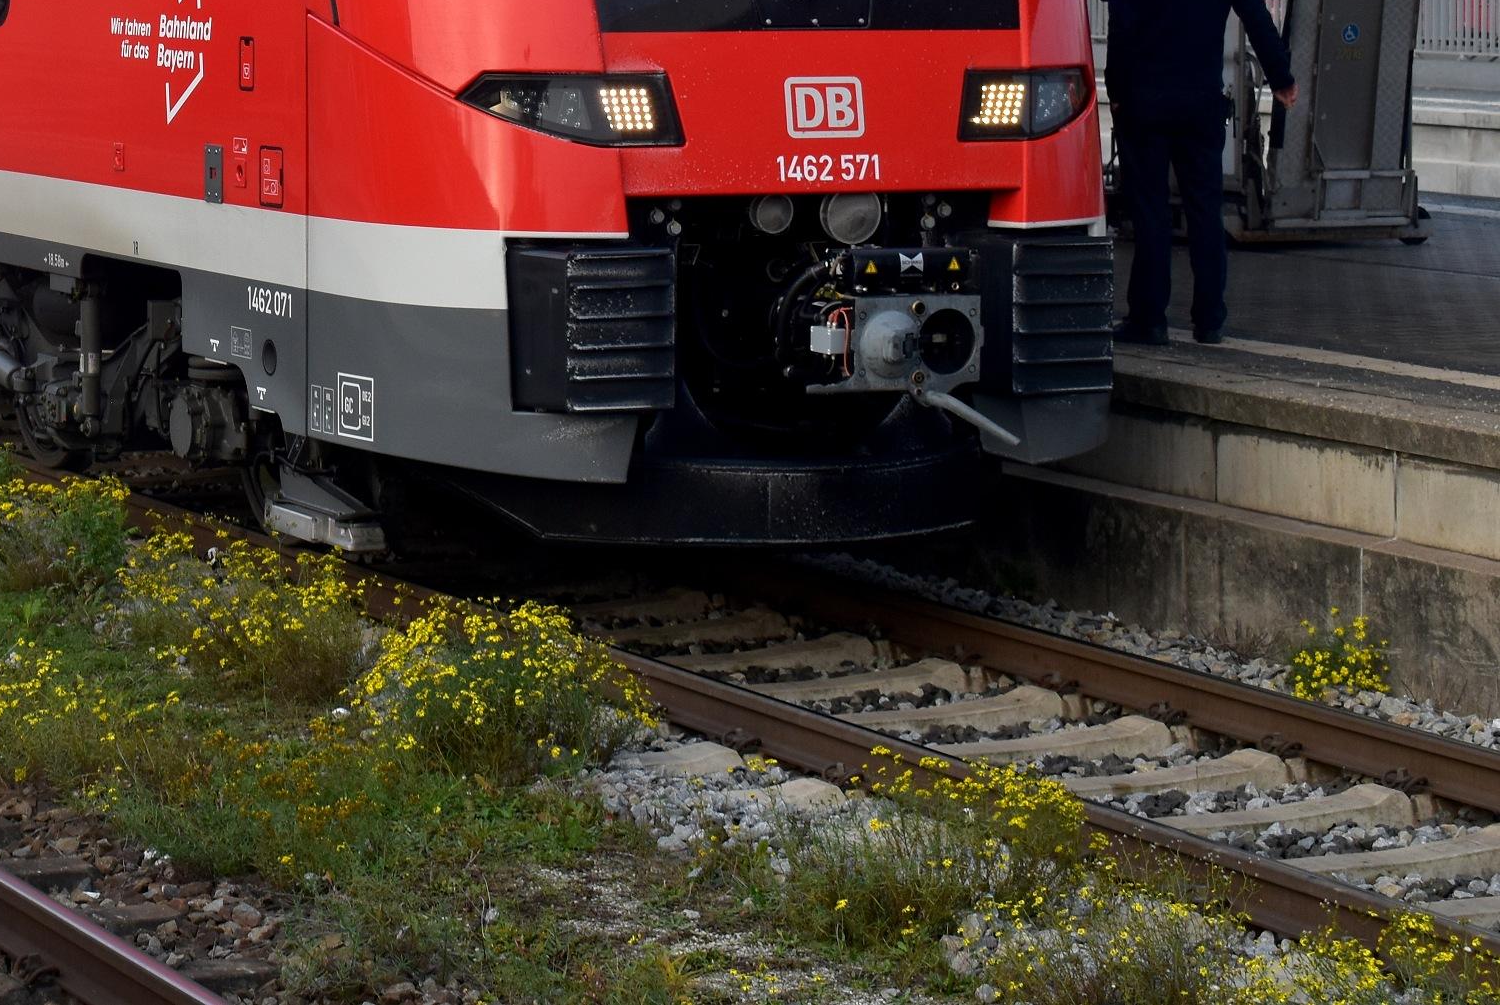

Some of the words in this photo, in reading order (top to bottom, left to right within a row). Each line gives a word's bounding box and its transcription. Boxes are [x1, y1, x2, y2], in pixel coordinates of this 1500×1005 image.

[110, 17, 124, 35] Wir
[125, 17, 151, 37] fahren
[159, 14, 212, 41] Bahnland
[120, 39, 132, 58] für
[133, 41, 150, 60] das
[156, 43, 195, 73] Bayern
[791, 84, 858, 131] DB
[776, 154, 834, 182] 1462
[840, 153, 880, 182] 571
[247, 285, 272, 314] 1462
[274, 289, 293, 318] 071
[344, 396, 354, 414] GC
